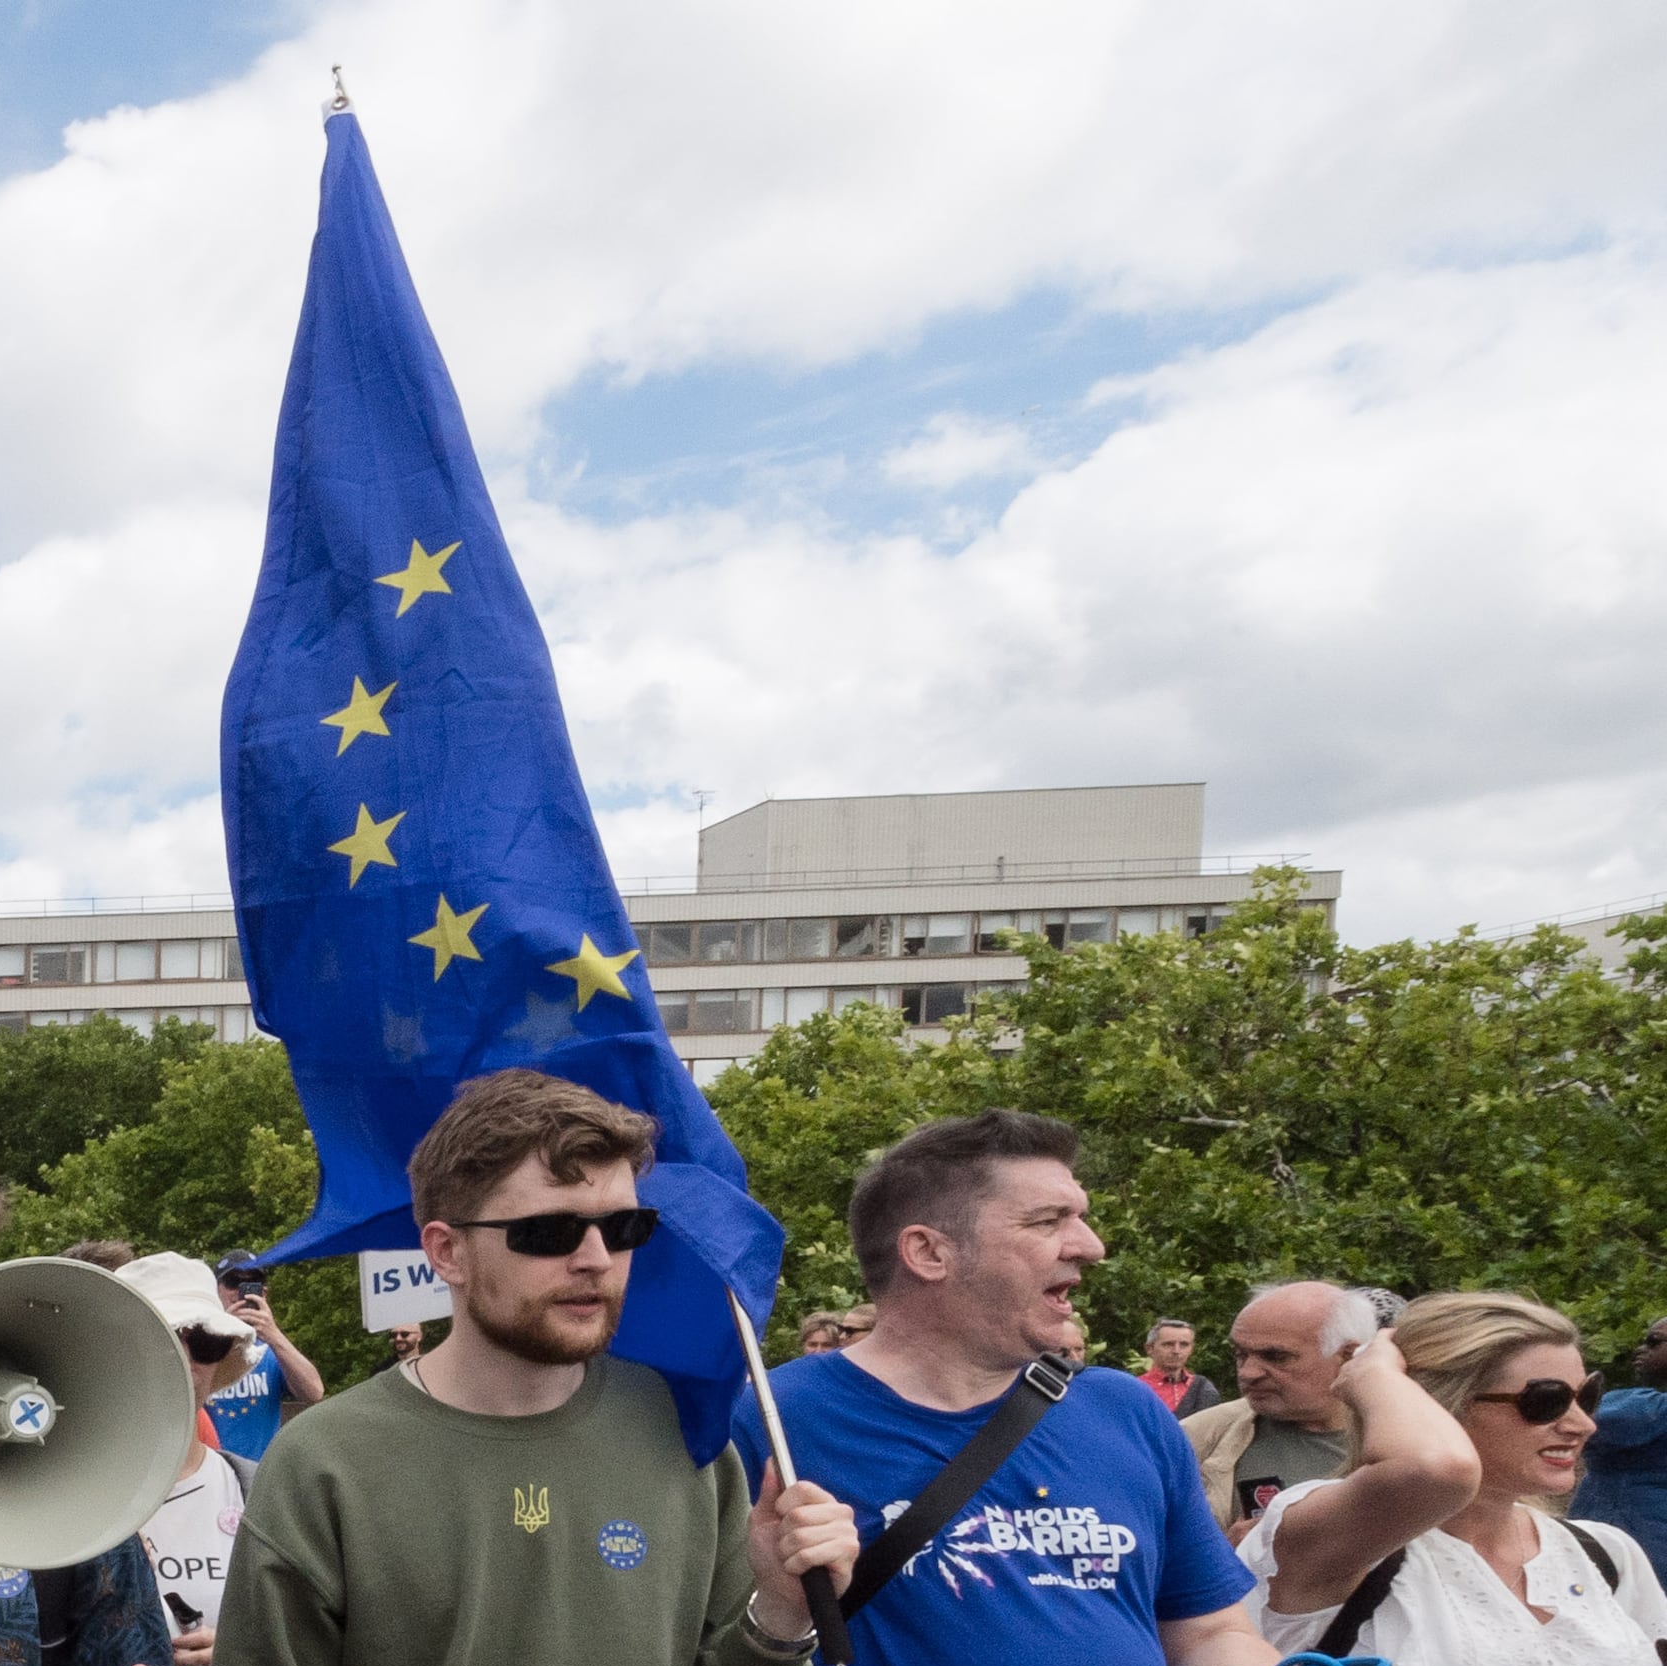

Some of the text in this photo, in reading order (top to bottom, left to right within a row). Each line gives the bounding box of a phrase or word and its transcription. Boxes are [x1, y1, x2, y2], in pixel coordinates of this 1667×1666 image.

[373, 1263, 435, 1295] IS W
[1014, 1507, 1100, 1528] HOLDS
[988, 1521, 1137, 1556] BARRED
[157, 1556, 226, 1581] OPE
